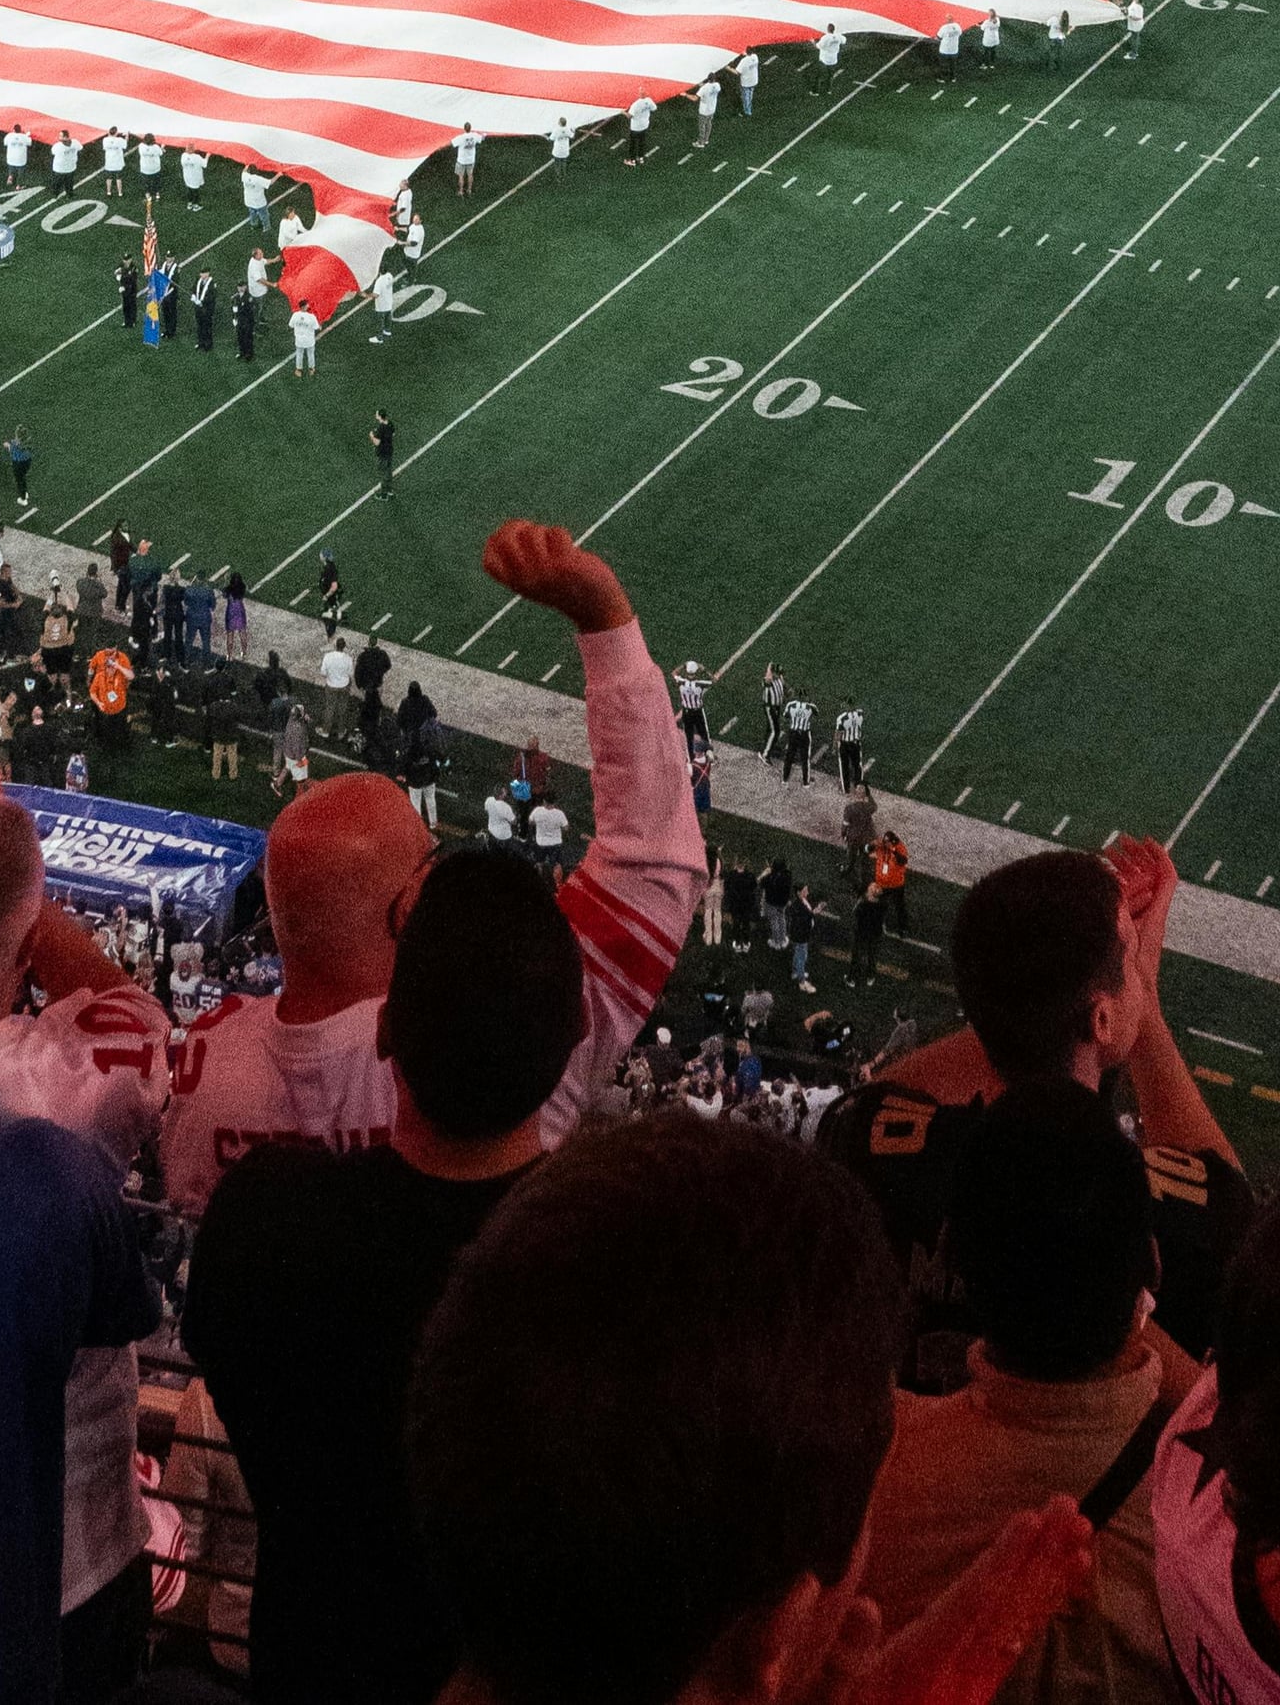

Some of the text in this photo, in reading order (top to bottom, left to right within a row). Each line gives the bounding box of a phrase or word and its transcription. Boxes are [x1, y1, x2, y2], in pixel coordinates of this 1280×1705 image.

[660, 355, 823, 422] 20
[1066, 458, 1237, 528] 10
[47, 826, 157, 869] NIGHT
